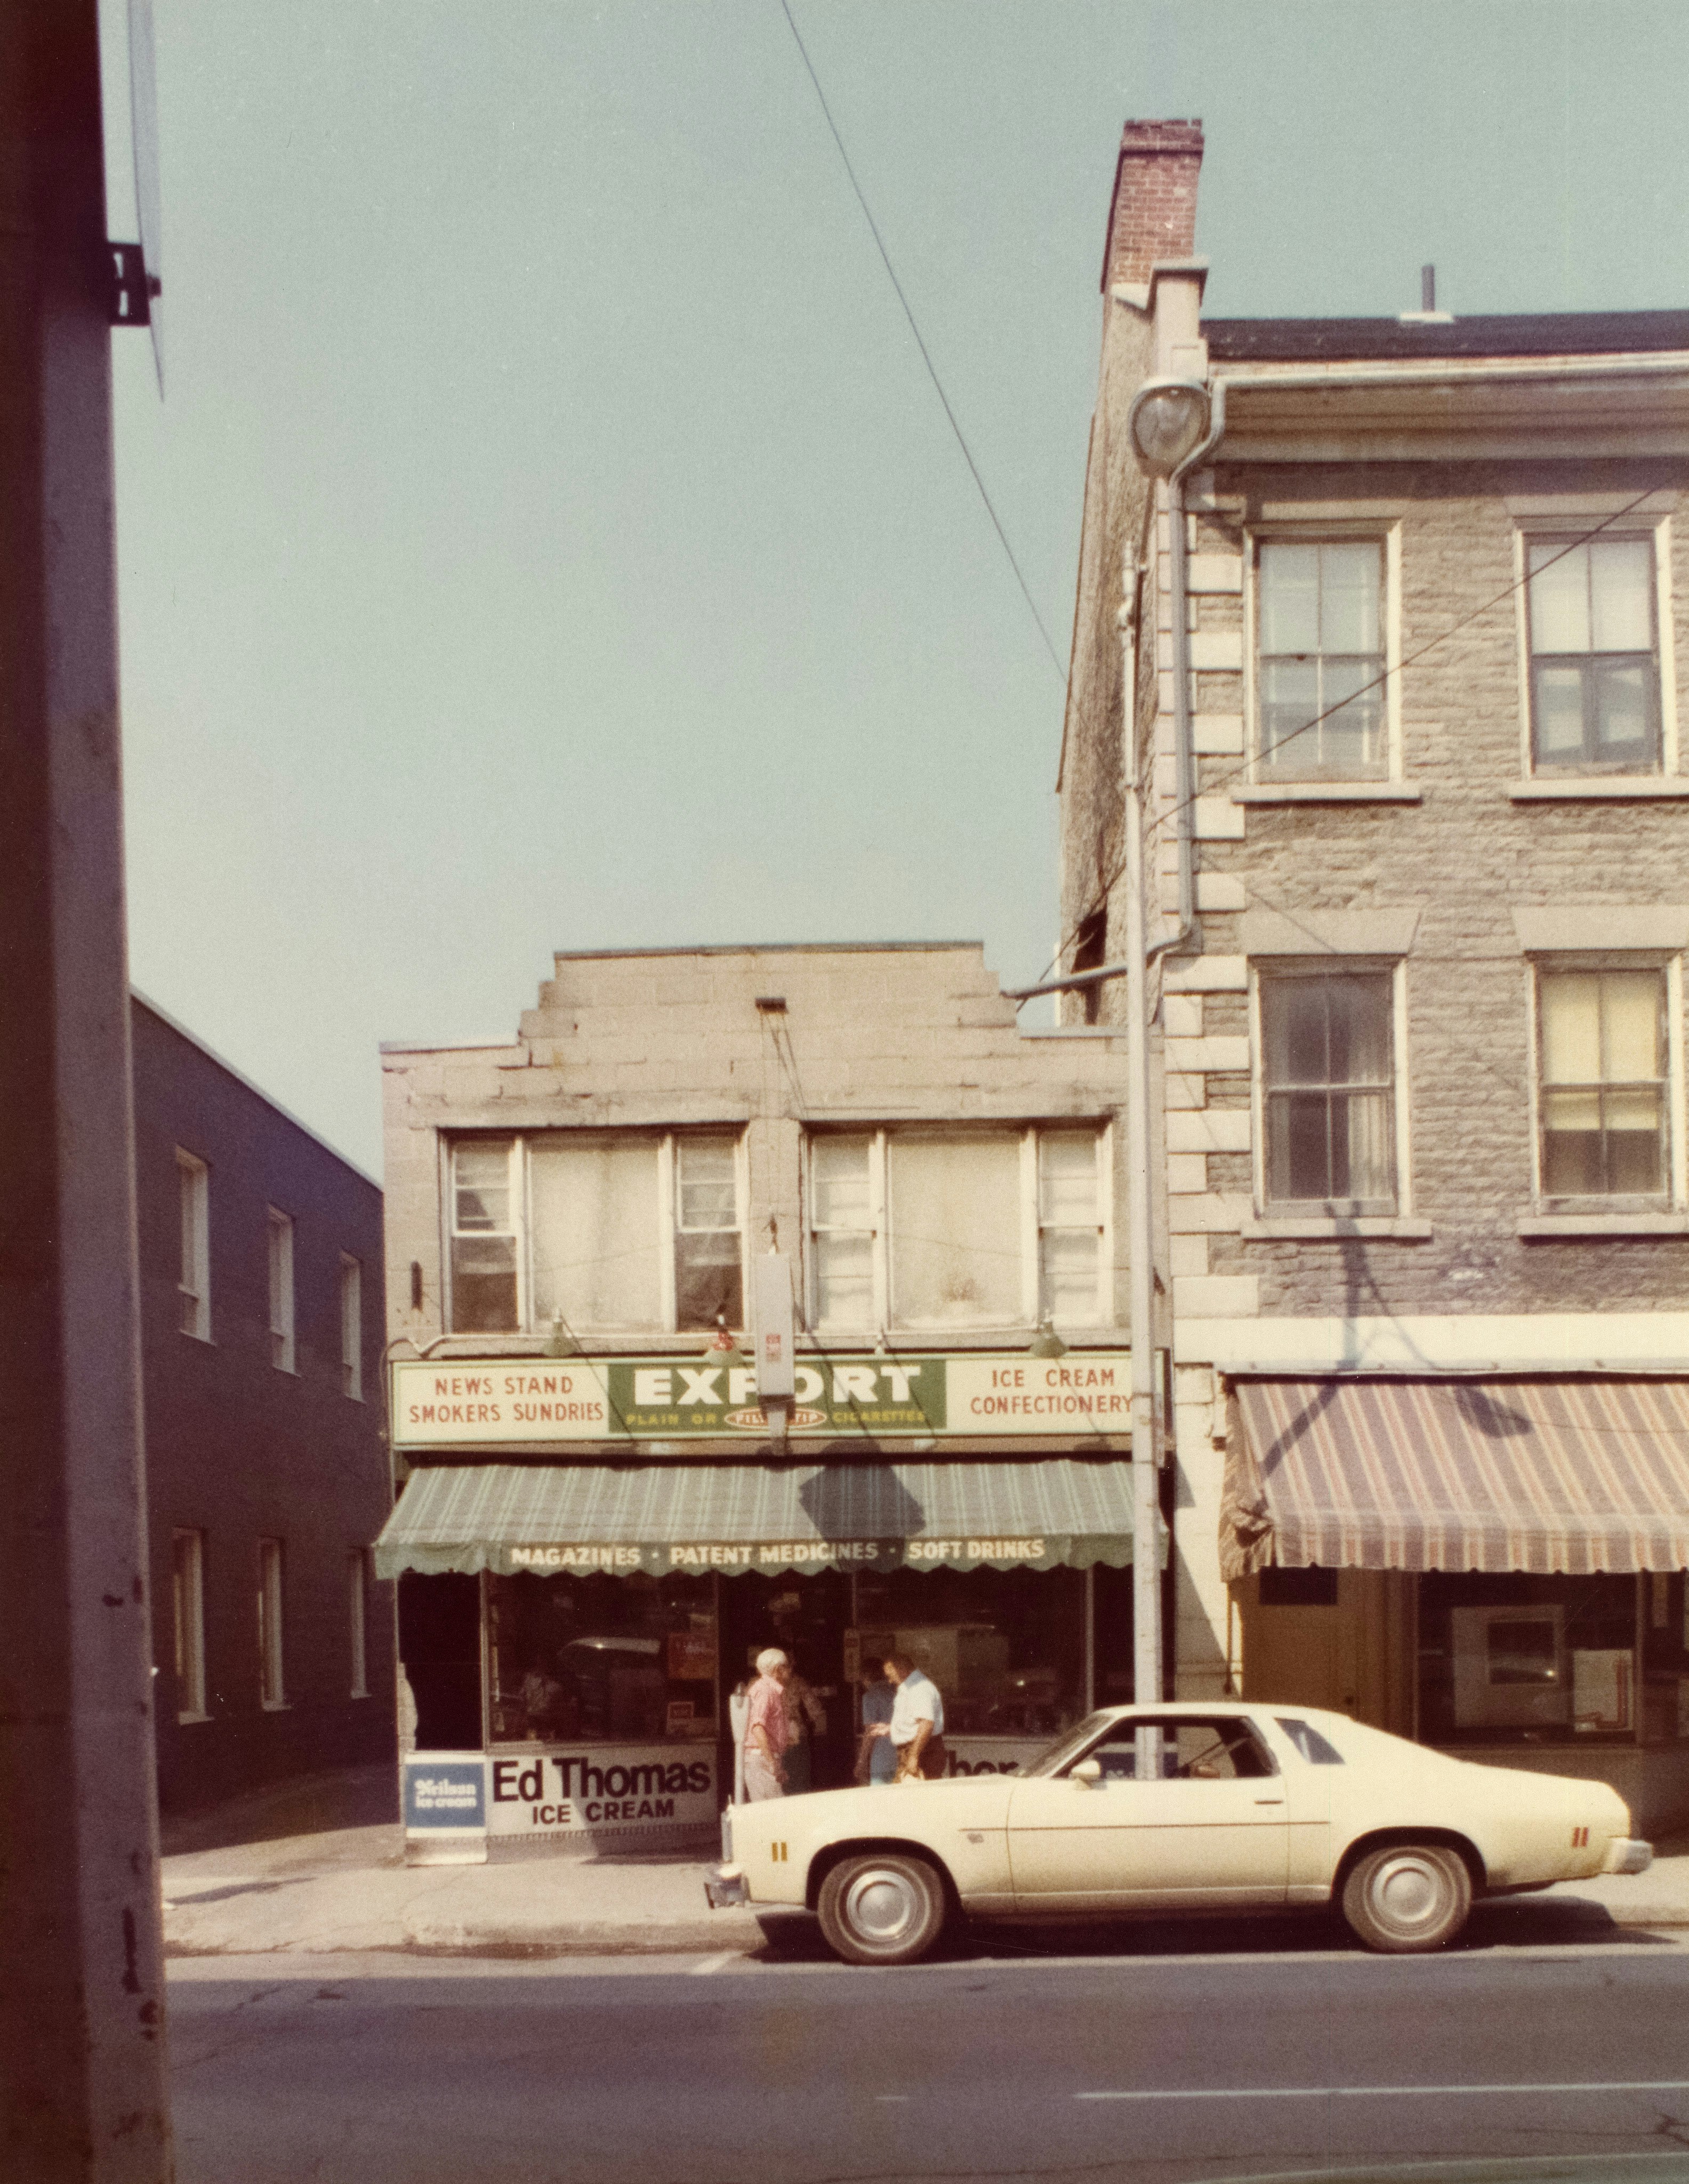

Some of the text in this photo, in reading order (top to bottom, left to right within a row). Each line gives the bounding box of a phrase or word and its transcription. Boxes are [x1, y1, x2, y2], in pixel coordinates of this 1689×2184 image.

[435, 1376, 573, 1396] NEWS STAND
[634, 1364, 921, 1405] EXPORT
[992, 1368, 1115, 1387] ICE CREAM
[409, 1402, 604, 1423] SMOKERS SUNDRIES
[970, 1395, 1133, 1415] CONFECTIONERY
[625, 1414, 679, 1425] PLAIN
[691, 1413, 718, 1425] OR
[511, 1539, 1045, 1566] MAGAZINES PATENT MEDICINES SOFT DRINKS
[493, 1756, 712, 1802] Ed Thomas
[533, 1800, 674, 1825] ICE CREAM
